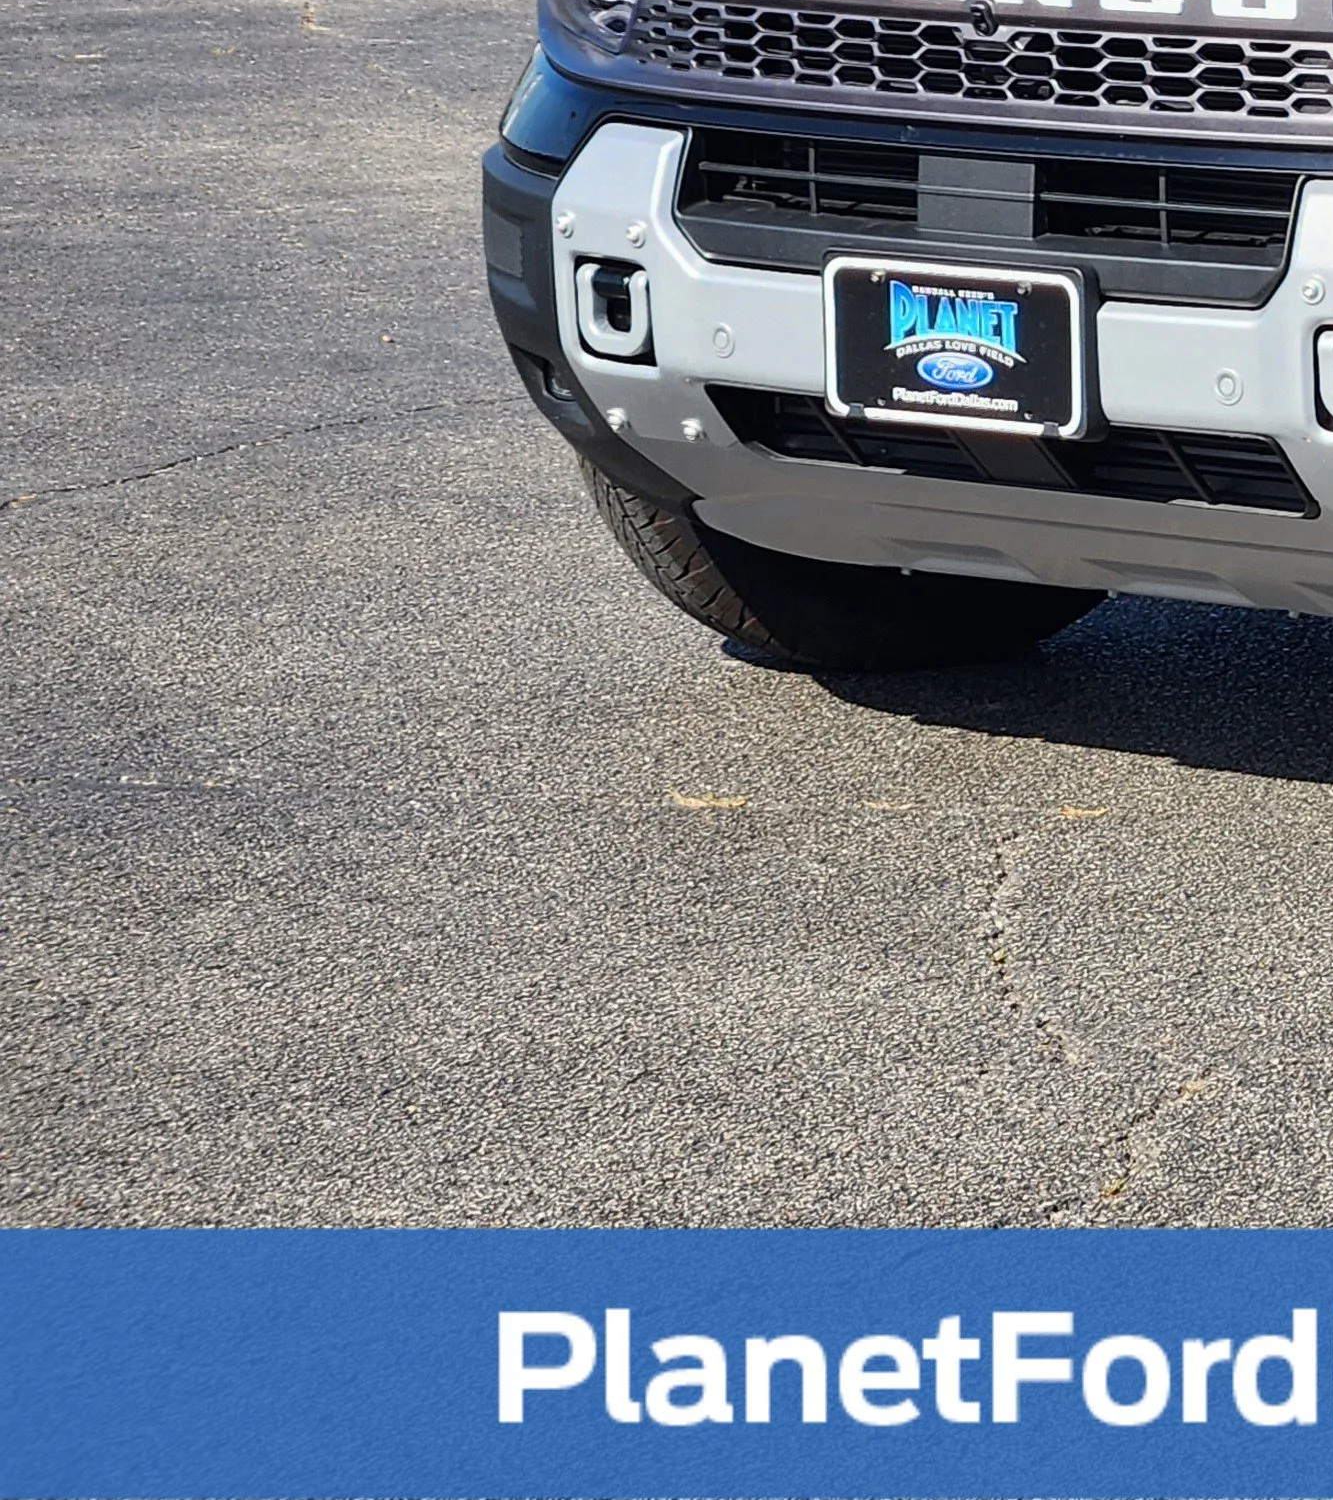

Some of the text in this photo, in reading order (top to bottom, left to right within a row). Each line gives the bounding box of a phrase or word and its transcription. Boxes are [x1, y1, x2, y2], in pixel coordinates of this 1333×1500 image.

[889, 280, 1018, 355] PLANET
[896, 339, 1015, 368] DALLAS LOVE FIELD
[931, 359, 978, 386] Ford
[892, 387, 1019, 413] PlanetFordDallas.com
